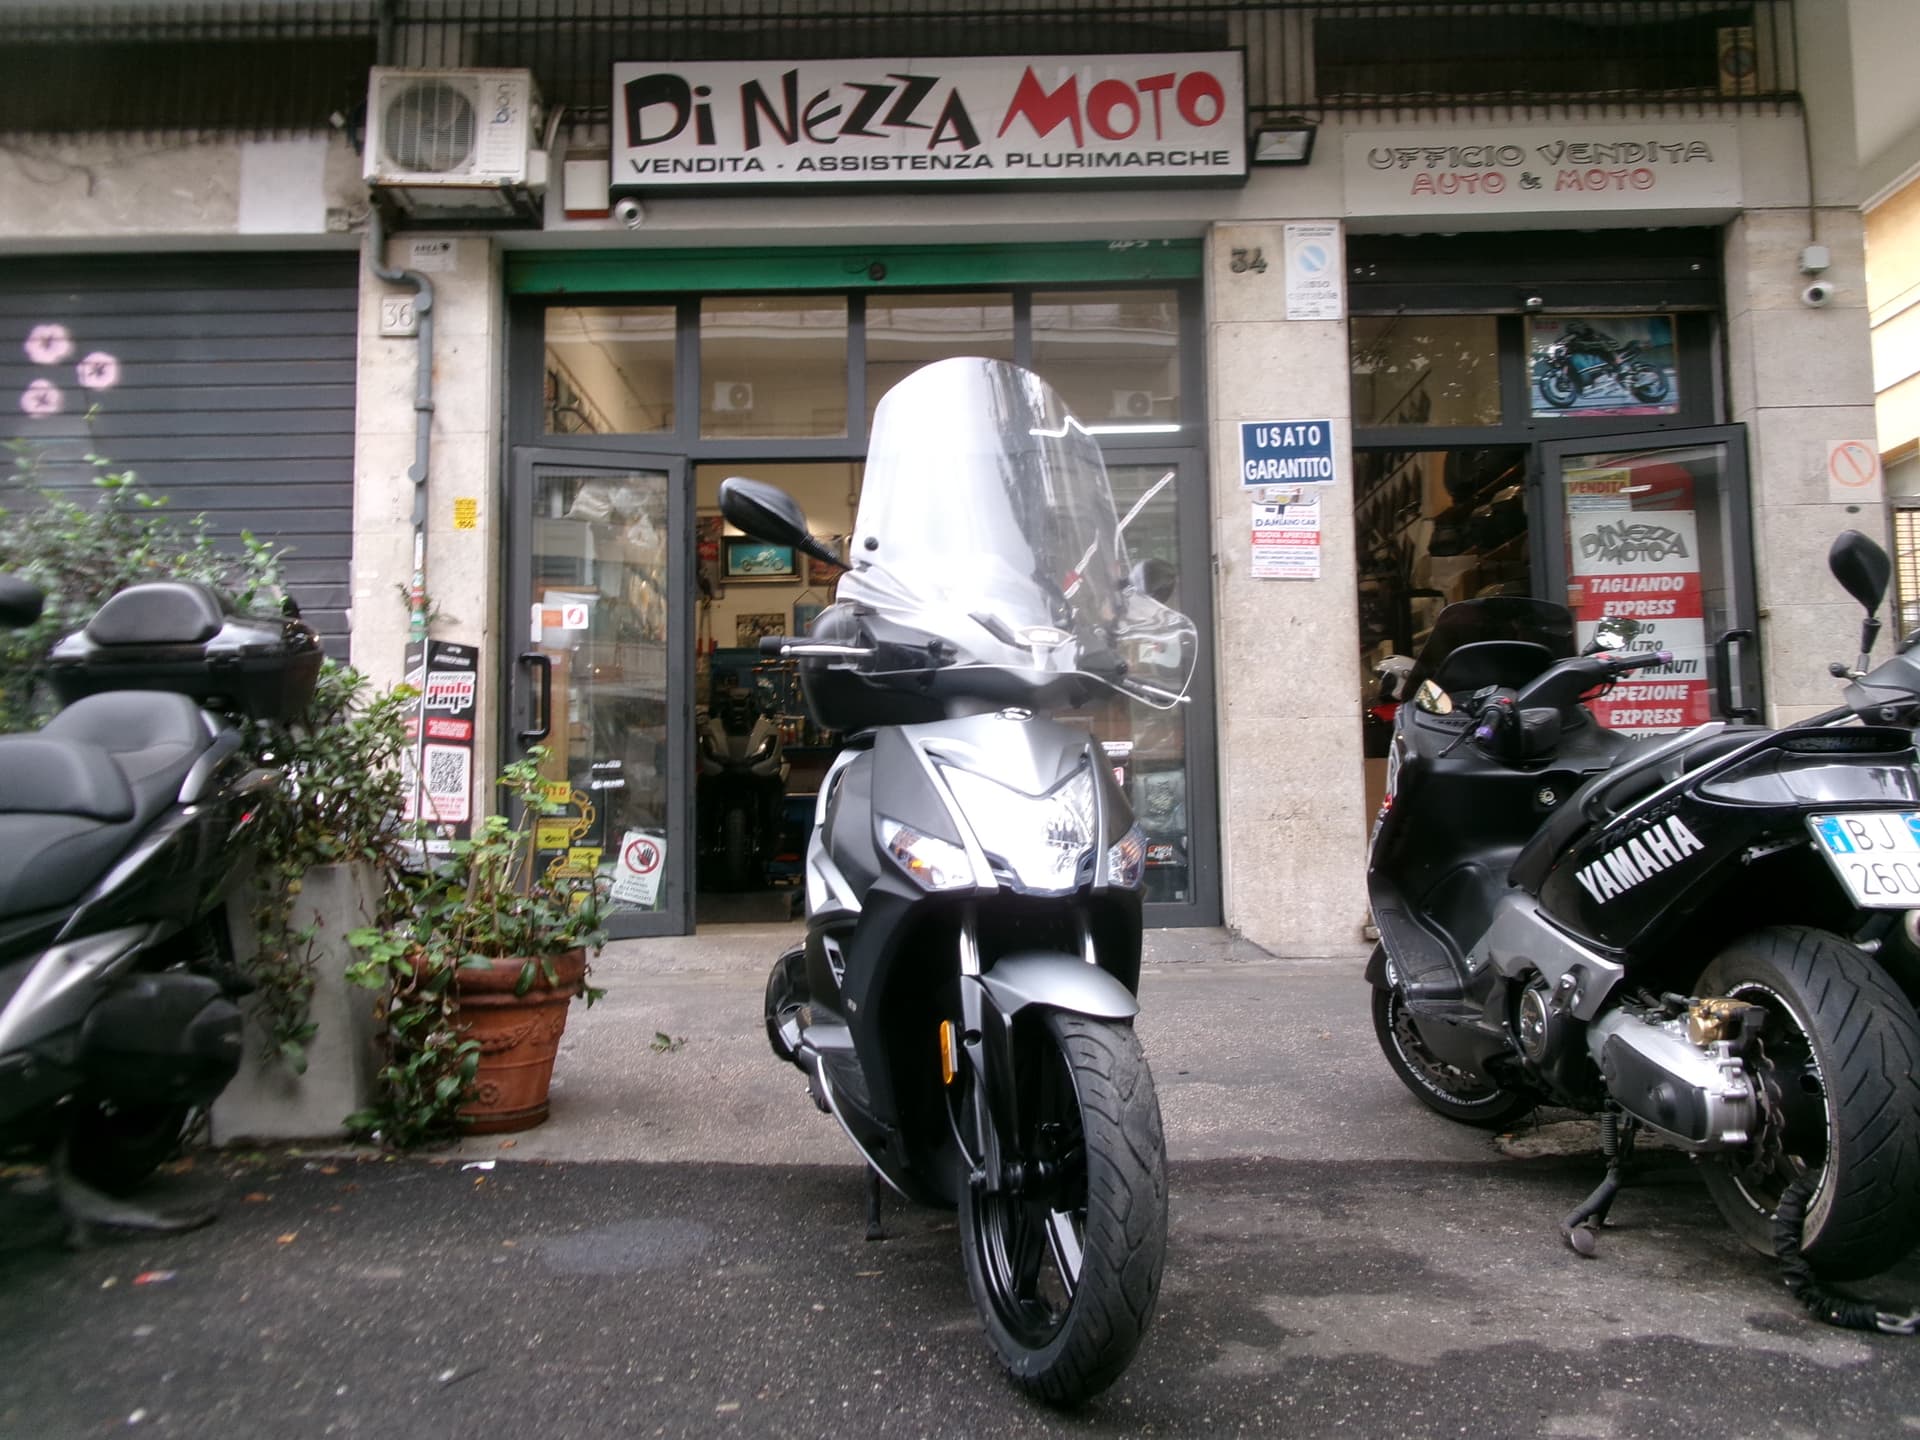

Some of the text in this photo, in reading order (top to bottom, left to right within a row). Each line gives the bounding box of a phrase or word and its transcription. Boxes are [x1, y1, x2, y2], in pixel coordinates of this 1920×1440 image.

[997, 65, 1225, 149] MOTO
[630, 157, 764, 174] VENDITA
[796, 153, 994, 173] ASSISTENZA
[1006, 150, 1231, 169] PLURIMARCHE
[1367, 140, 1714, 170] UFFICIO VENDITA
[1410, 167, 1656, 196] AUTO & MOTO
[1230, 247, 1268, 274] 34
[383, 302, 415, 328] 36
[1256, 425, 1322, 448] USATO
[1245, 456, 1332, 481] GARANTITO
[1591, 575, 1685, 594] TAGLIANDO
[1603, 599, 1677, 617] EXPRESS
[429, 681, 472, 695] moto
[427, 694, 470, 711] days
[1610, 708, 1684, 726] EXPRESS
[1845, 818, 1895, 851] BJ
[1575, 814, 1705, 905] YAMAHA
